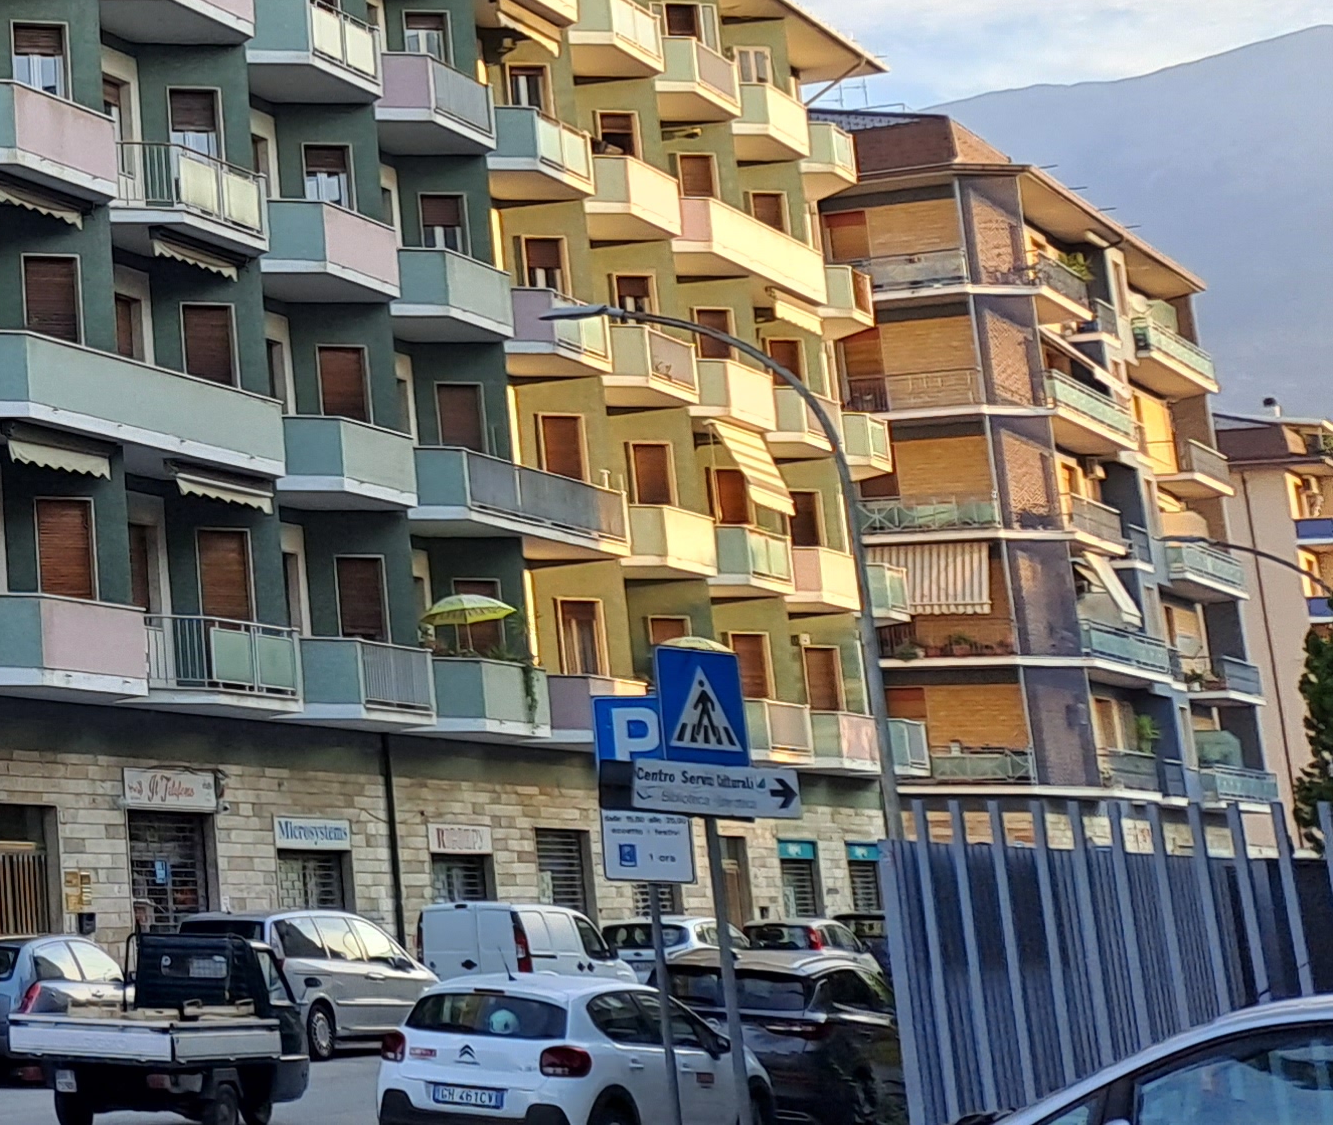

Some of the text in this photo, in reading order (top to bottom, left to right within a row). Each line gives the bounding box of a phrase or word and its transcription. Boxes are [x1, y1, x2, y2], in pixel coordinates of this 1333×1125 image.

[612, 707, 660, 760] P
[636, 767, 676, 783] Centro
[278, 820, 348, 846] Microsystems
